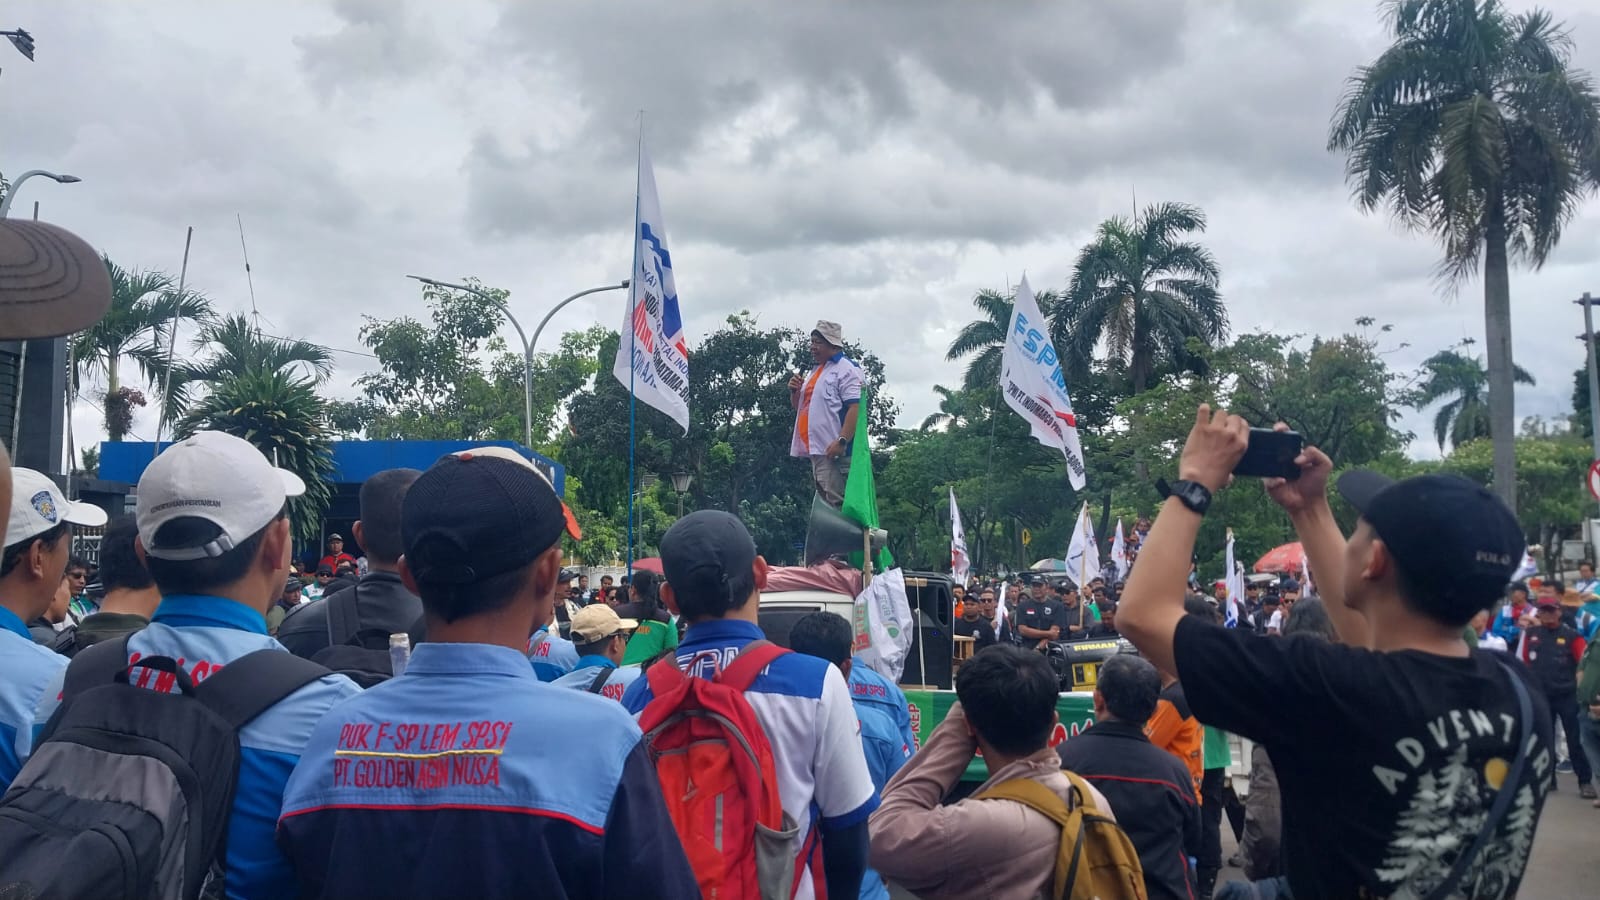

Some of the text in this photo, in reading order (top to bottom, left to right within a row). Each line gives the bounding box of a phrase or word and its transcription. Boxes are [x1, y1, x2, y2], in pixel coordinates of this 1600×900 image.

[1476, 551, 1511, 565] POLO
[1073, 642, 1117, 651] FIRMAN
[337, 723, 374, 749] PUK
[375, 722, 419, 750] F-SP
[420, 722, 461, 751] LEM
[334, 758, 351, 788] PT.
[354, 758, 415, 788] GOLDEN
[452, 756, 499, 787] NUSA
